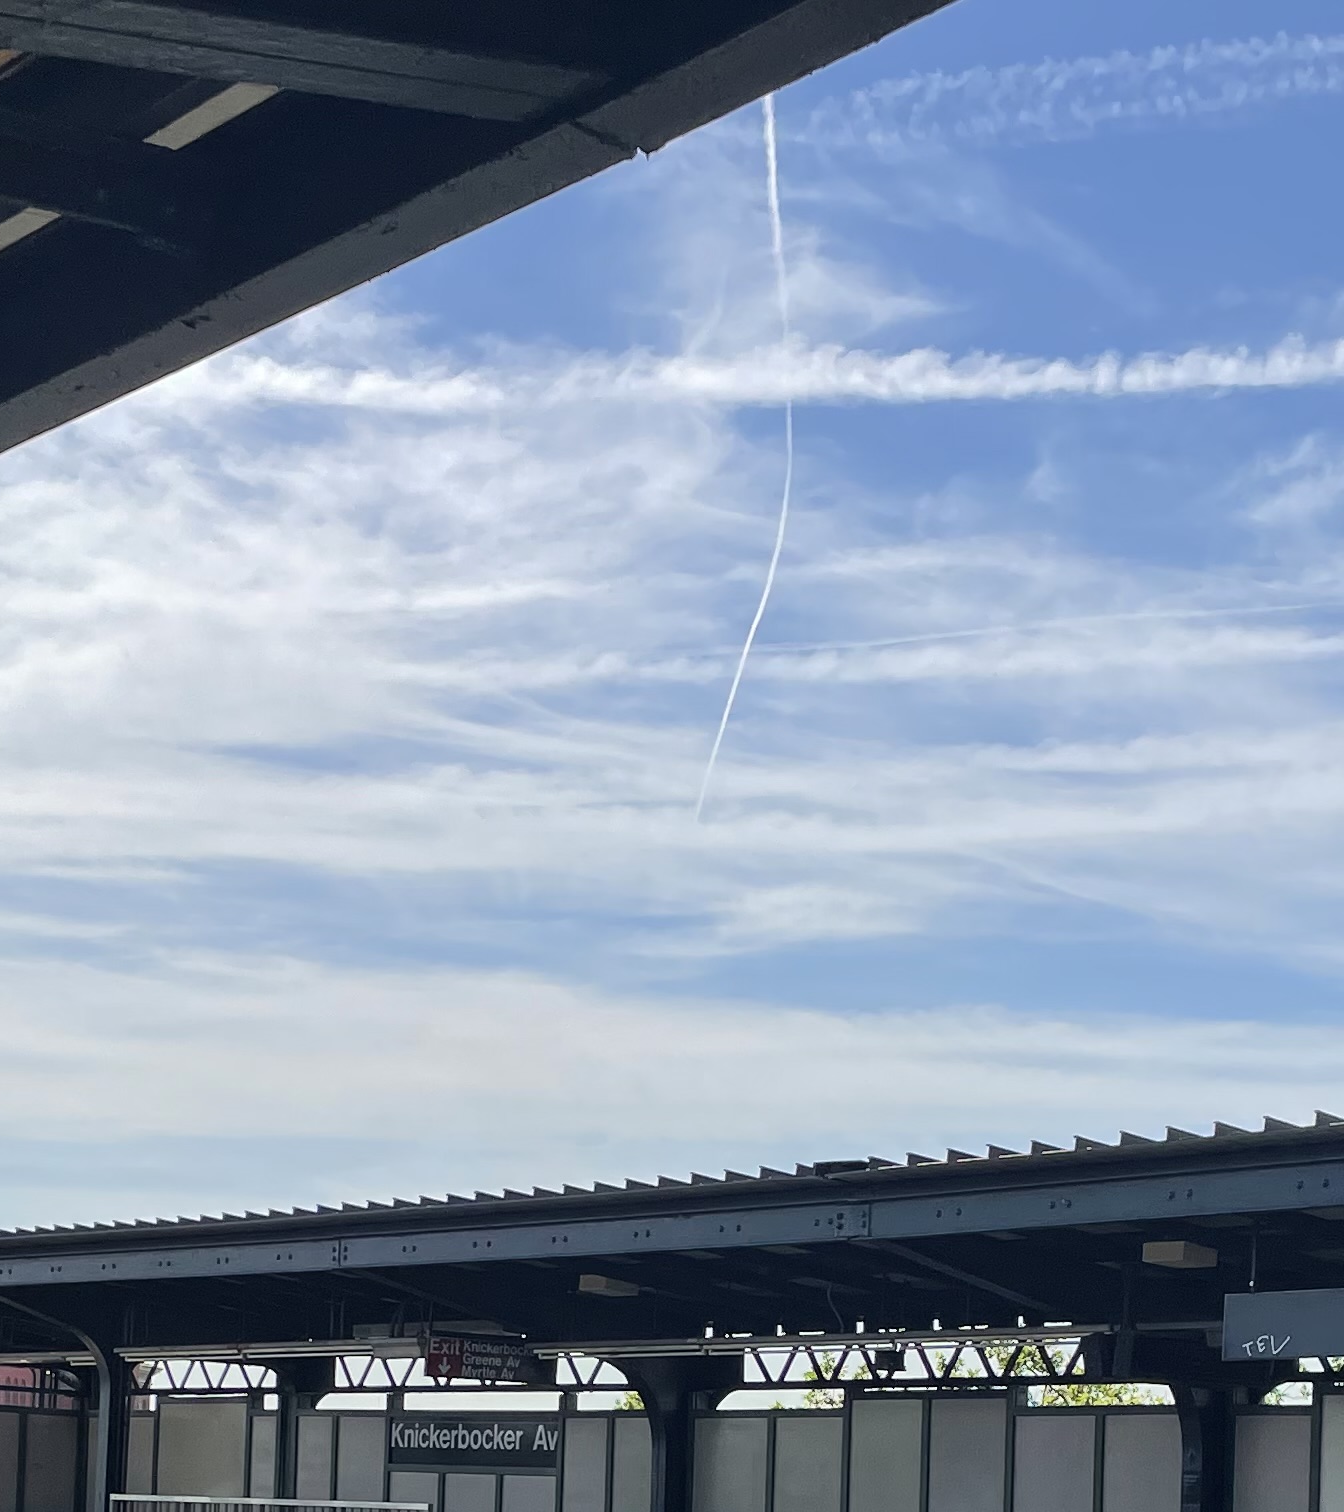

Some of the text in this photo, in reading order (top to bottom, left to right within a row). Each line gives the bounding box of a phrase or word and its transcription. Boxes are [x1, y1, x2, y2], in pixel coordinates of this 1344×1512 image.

[430, 1339, 460, 1355] Exit
[463, 1353, 521, 1368] Greene Av
[461, 1365, 515, 1380] Myrtle Av
[391, 1423, 559, 1451] Knickerbocker Av
